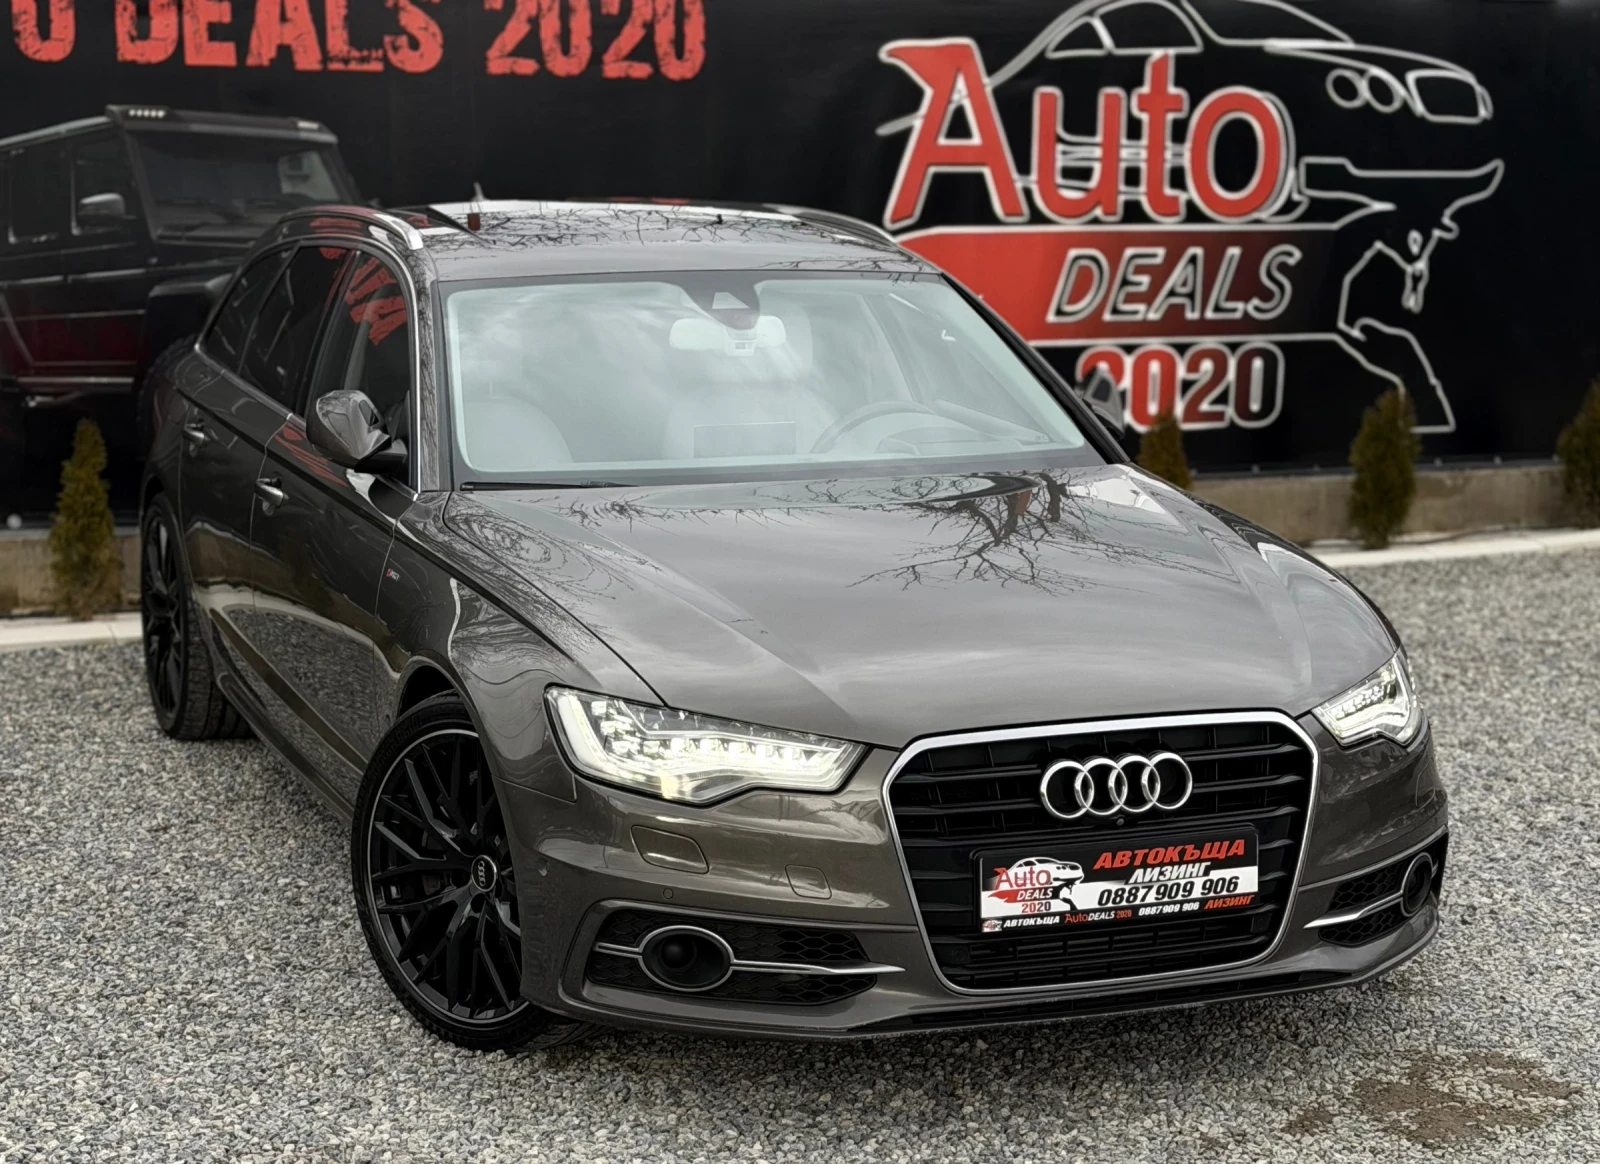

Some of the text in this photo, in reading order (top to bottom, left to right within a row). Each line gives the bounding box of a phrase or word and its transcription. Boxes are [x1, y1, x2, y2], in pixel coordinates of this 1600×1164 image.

[485, 0, 706, 80] 2020
[880, 38, 1292, 229] Auto
[1046, 246, 1302, 323] DEALS
[1093, 839, 1245, 870] АВТОКЪЩА
[993, 866, 1052, 890] Auto
[1128, 862, 1211, 884] ЛИЗИНГ
[1017, 888, 1053, 900] DEALS
[1021, 901, 1051, 913] 2020
[1097, 876, 1239, 907] 0887 909 906
[1003, 916, 1060, 928] АВТОКЪЩА
[1116, 909, 1132, 919] 2020
[1182, 902, 1200, 912] 906
[1204, 895, 1255, 910] ЛИЗИНГ
